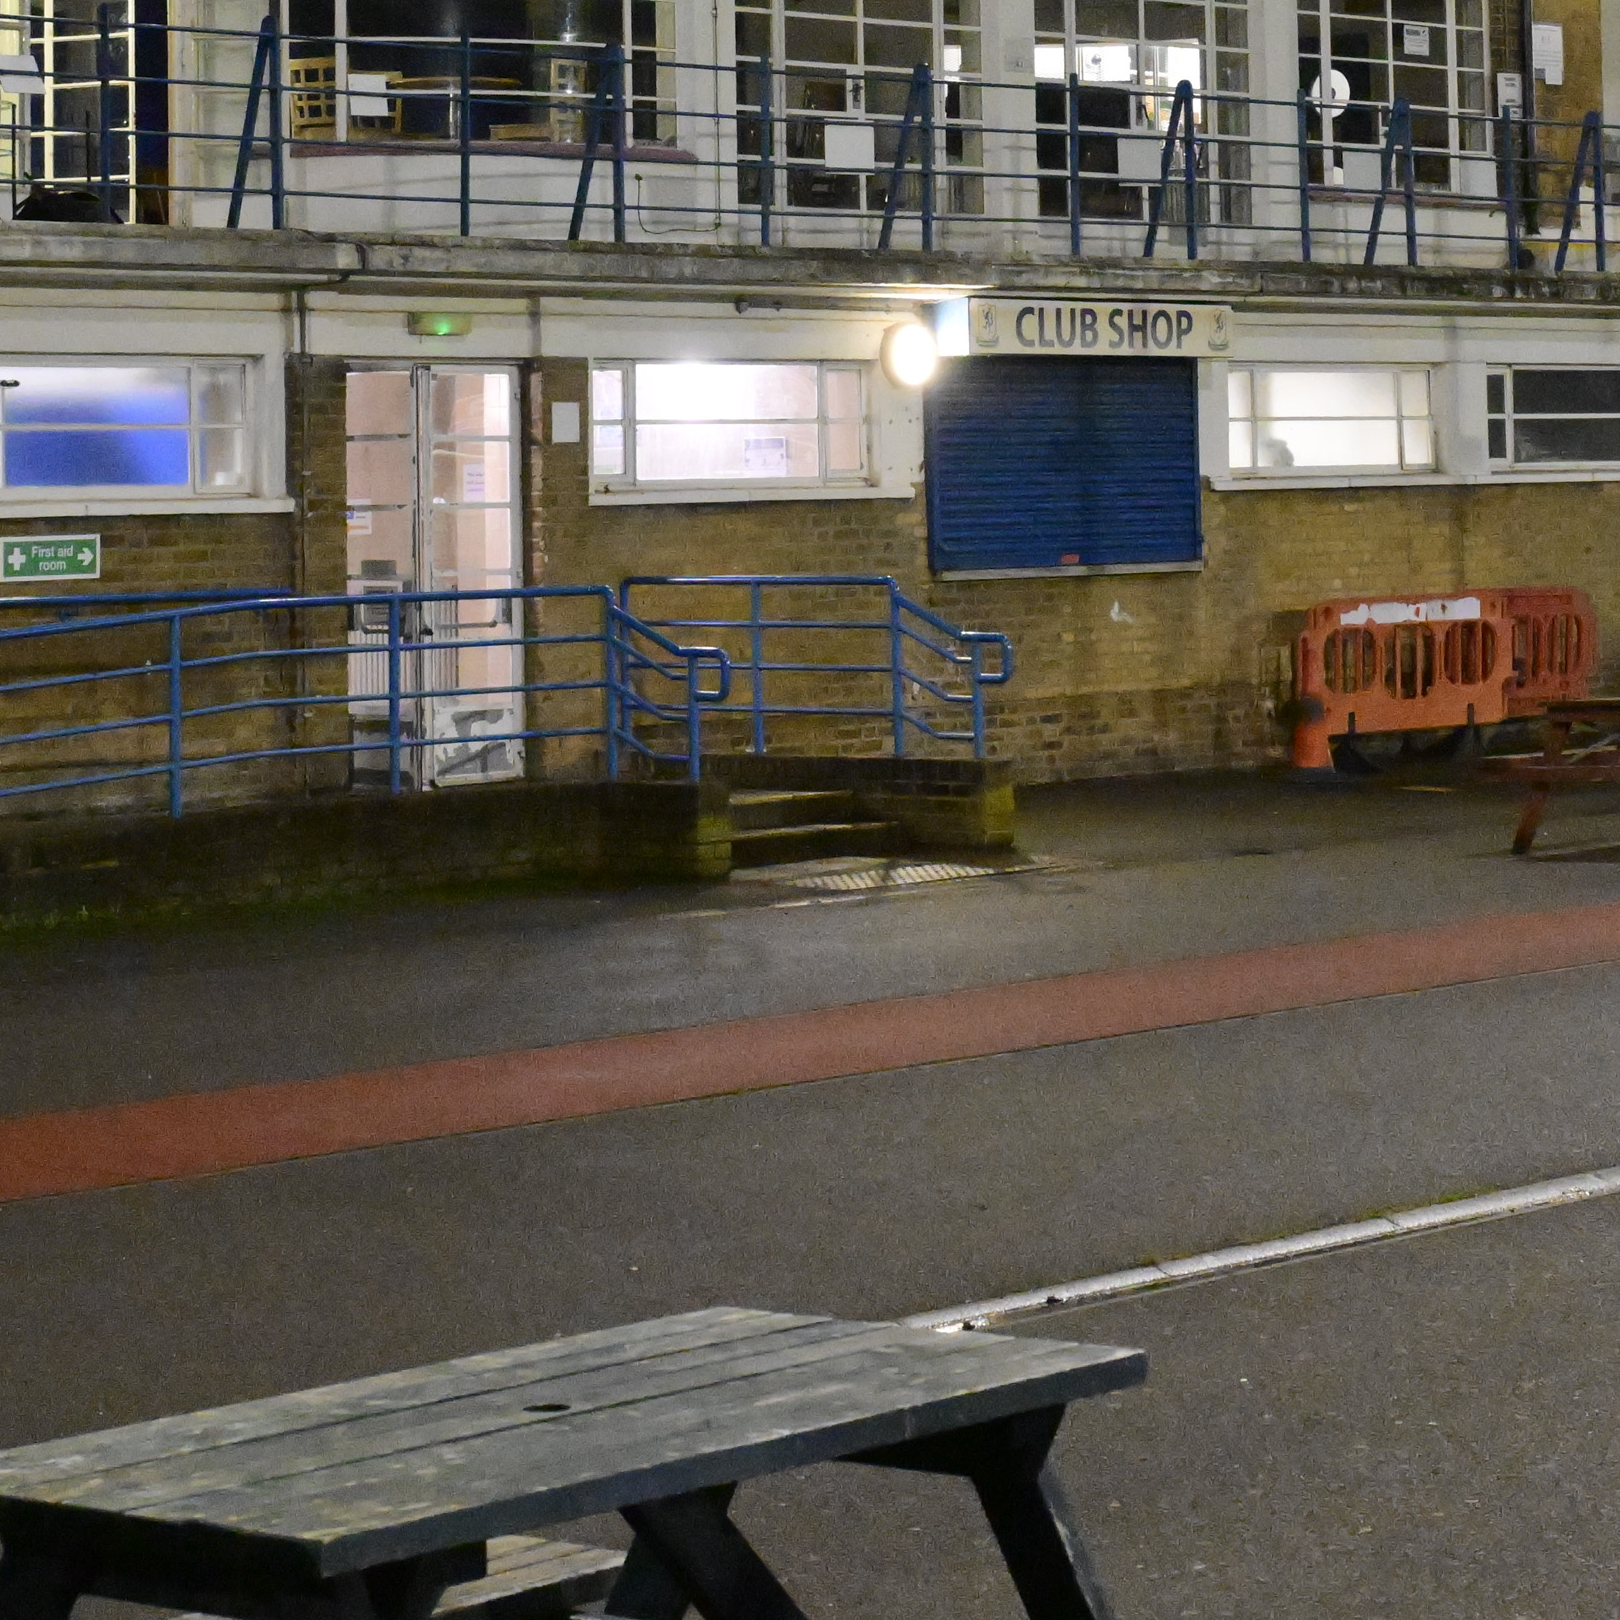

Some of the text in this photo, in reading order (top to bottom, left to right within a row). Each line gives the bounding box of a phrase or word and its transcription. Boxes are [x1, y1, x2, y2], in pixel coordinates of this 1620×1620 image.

[1015, 306, 1193, 350] CLUB SHOP
[31, 544, 74, 558] First aid
[39, 560, 67, 571] room
